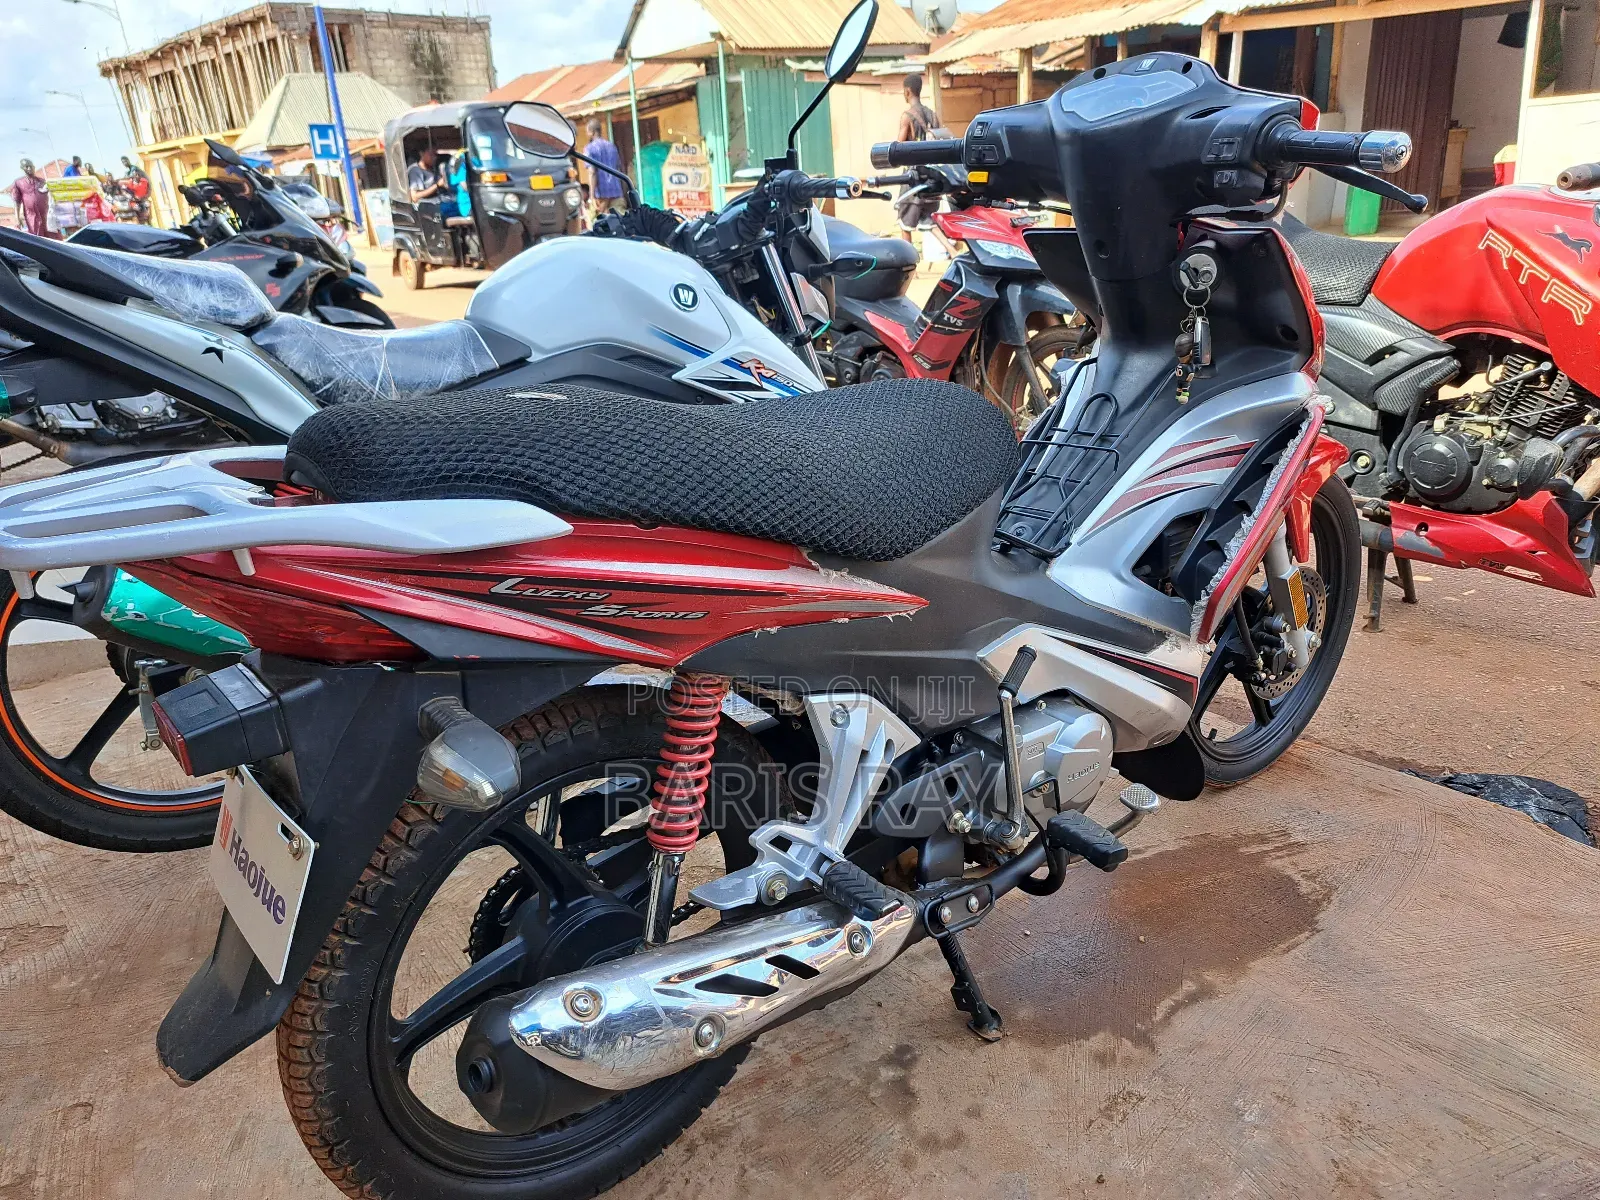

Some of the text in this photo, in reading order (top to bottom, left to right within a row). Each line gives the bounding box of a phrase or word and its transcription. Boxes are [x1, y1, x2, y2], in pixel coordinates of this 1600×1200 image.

[312, 128, 338, 155] H
[1478, 229, 1592, 325] RTR
[943, 312, 963, 326] TVS
[229, 827, 286, 925] Haojue
